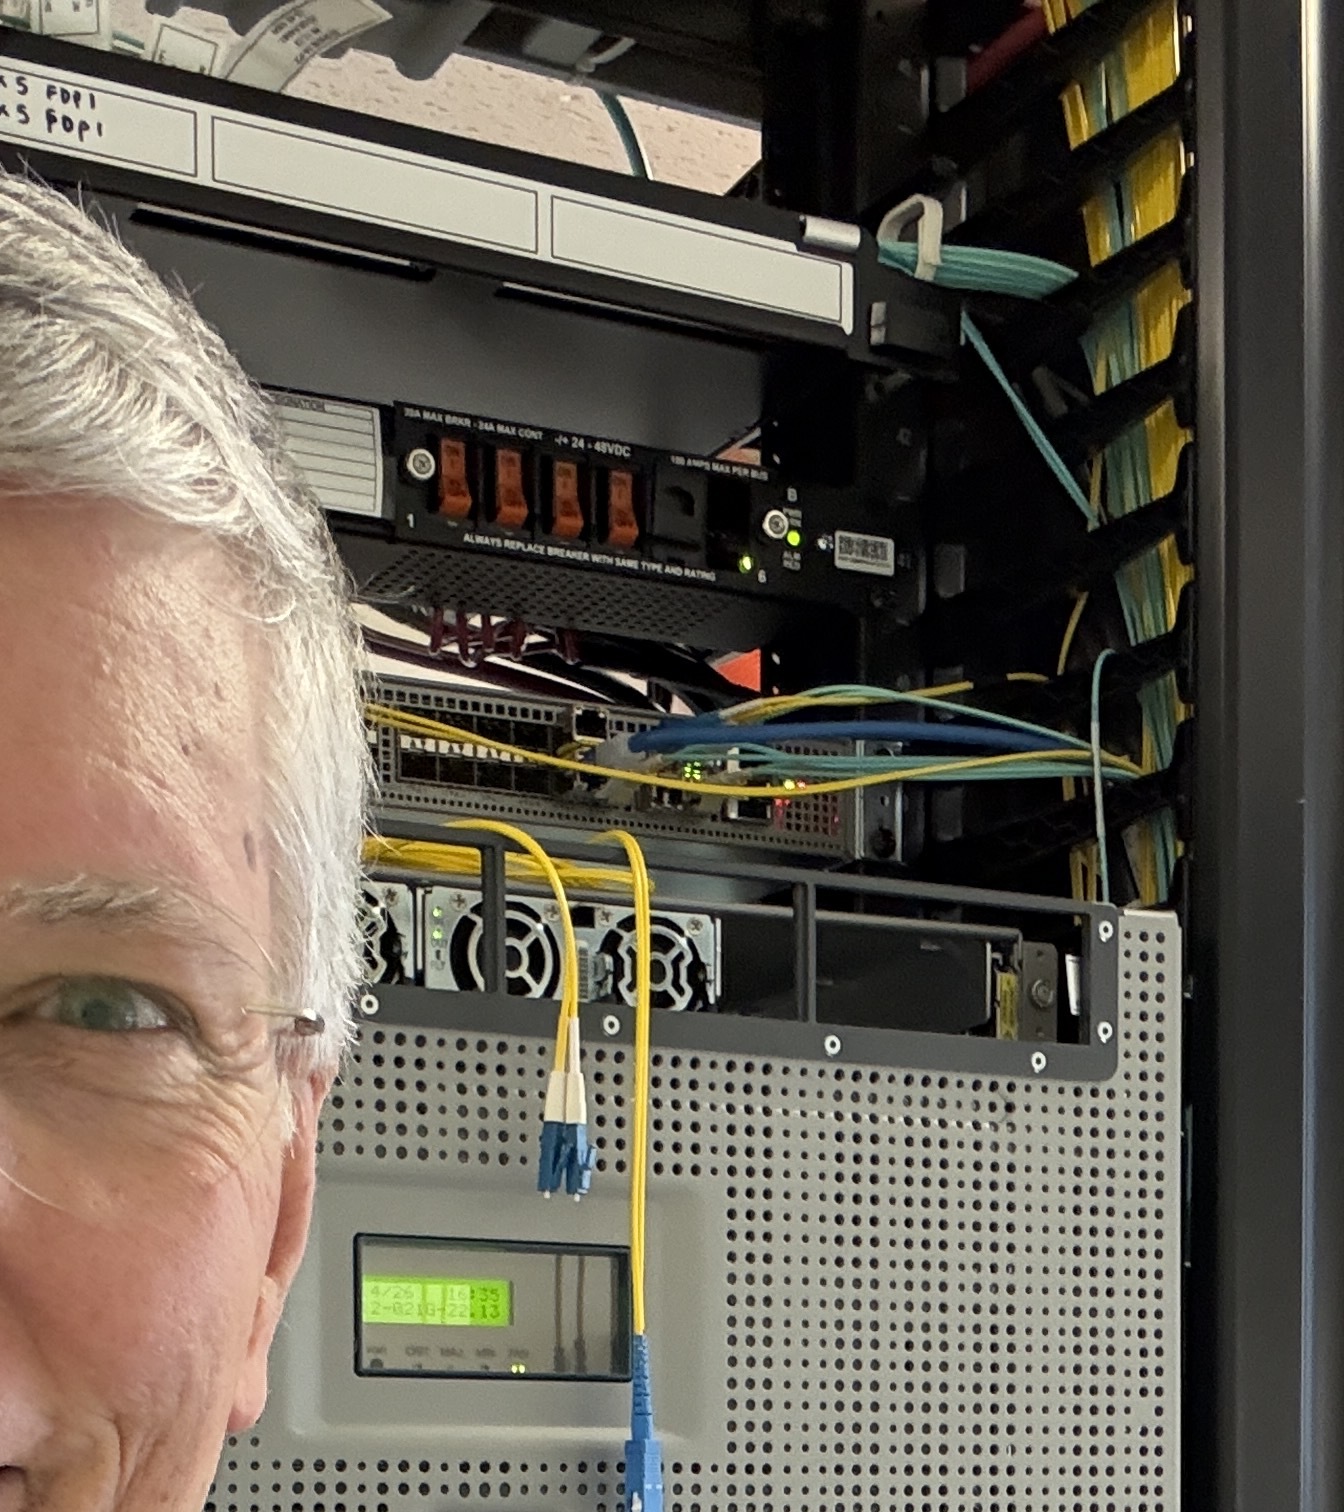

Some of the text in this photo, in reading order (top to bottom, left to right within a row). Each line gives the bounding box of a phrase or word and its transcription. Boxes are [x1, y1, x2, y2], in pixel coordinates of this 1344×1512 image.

[423, 409, 444, 424] MAX
[496, 422, 517, 437] MAX
[571, 436, 586, 451] 24
[406, 513, 415, 529] 1
[463, 532, 717, 582] ALWAYS REPLACE BREAKER WITH SAME TYPE AND RATING
